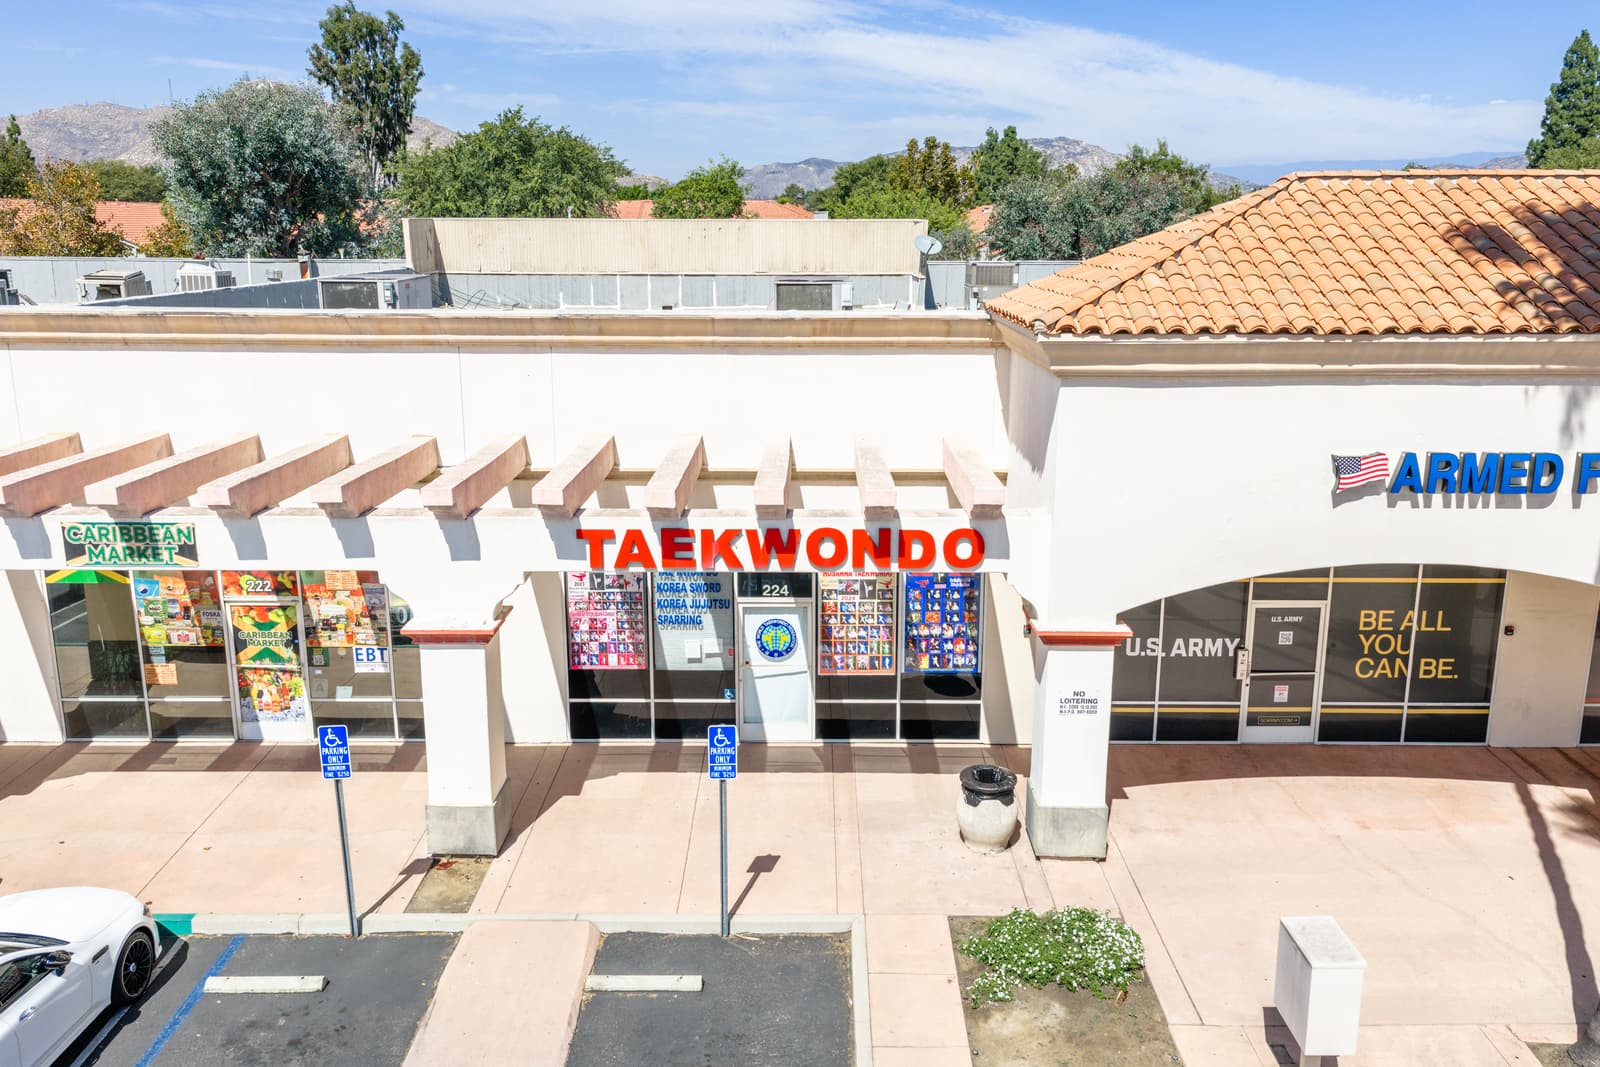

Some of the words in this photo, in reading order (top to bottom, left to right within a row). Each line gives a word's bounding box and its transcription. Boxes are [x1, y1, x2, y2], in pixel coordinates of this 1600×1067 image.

[1390, 452, 1564, 494] ARMED
[66, 525, 194, 544] CARIBBEAN
[87, 545, 177, 563] MARKET
[576, 527, 986, 570] TAEKWONDO
[247, 580, 272, 592] 222
[656, 582, 688, 593] KOREA
[690, 582, 721, 593] SWORD
[762, 584, 789, 597] 224
[657, 599, 688, 609] KOREA
[690, 599, 730, 609] JUJUTSU
[657, 615, 703, 625] SPARRING
[1359, 610, 1395, 631] BE
[1400, 610, 1452, 631] ALL
[239, 631, 292, 640] CARIBBEAN
[247, 639, 286, 647] MARKET
[1125, 637, 1165, 657] U.S.
[1170, 636, 1241, 657] ARMY
[1359, 633, 1413, 655] YOU
[355, 647, 388, 662] EBT
[1355, 657, 1410, 680] CAN
[1418, 657, 1459, 680] BE.
[322, 747, 347, 755] PARKING
[711, 747, 735, 755] PARKING
[328, 755, 343, 763] ONLY
[715, 755, 730, 763] ONLY
